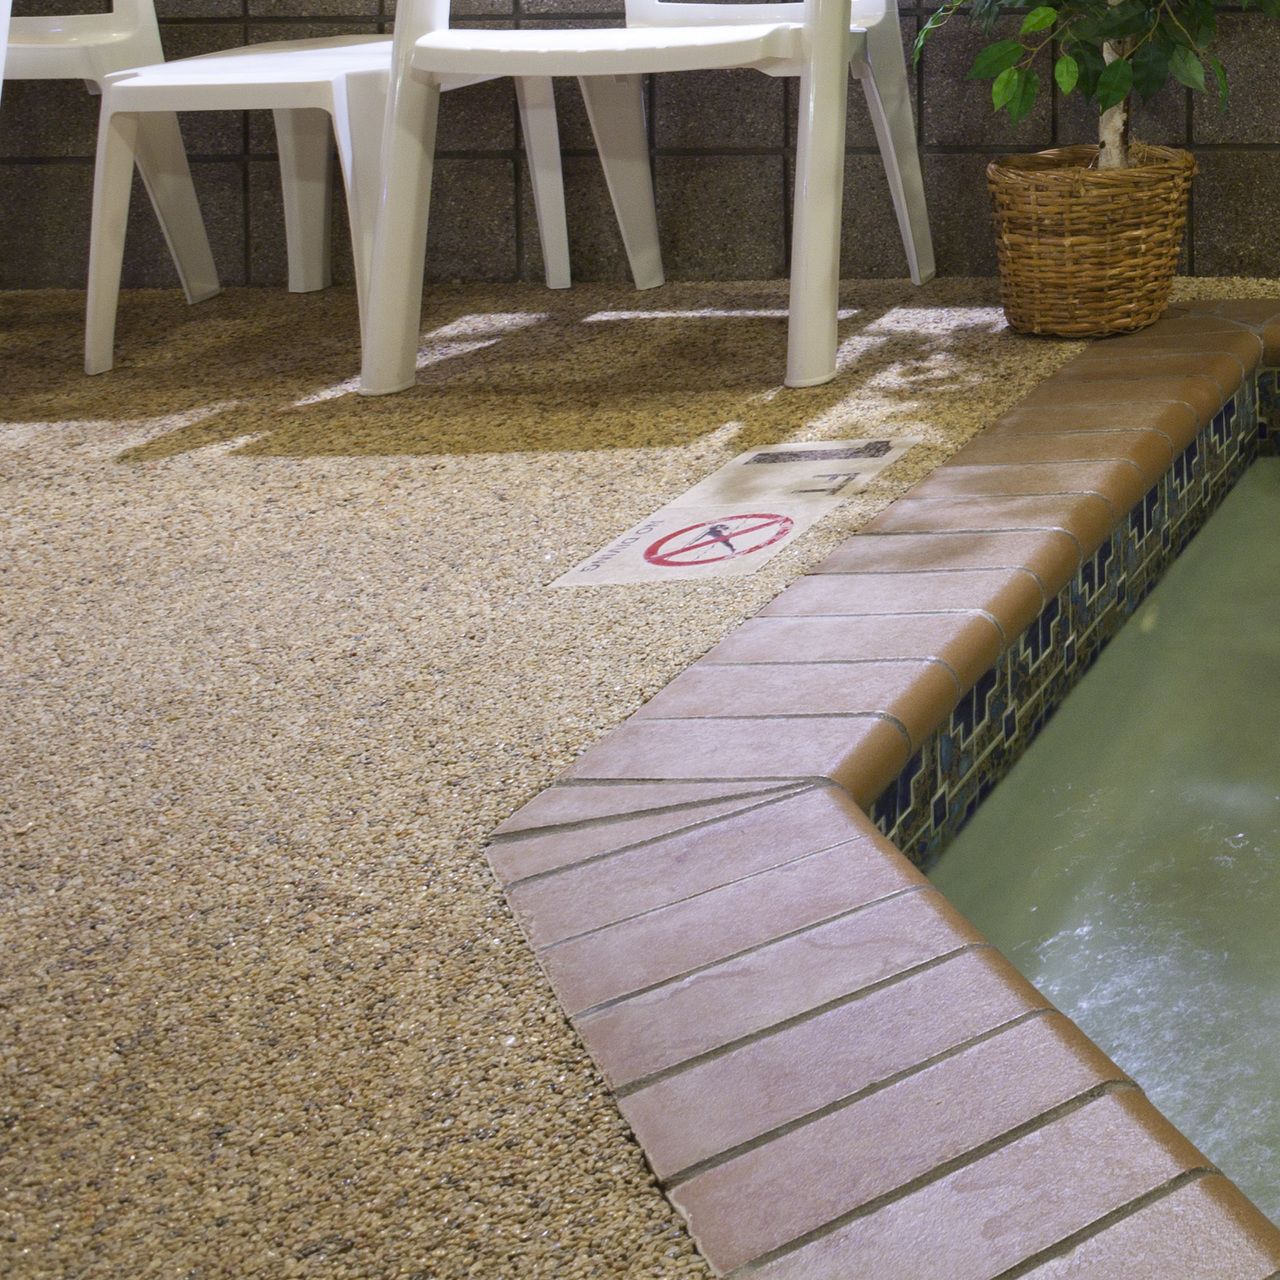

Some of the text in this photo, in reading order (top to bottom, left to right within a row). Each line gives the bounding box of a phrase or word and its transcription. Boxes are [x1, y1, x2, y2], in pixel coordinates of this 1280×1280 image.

[791, 472, 862, 496] FT
[579, 519, 664, 572] NO DIVING
